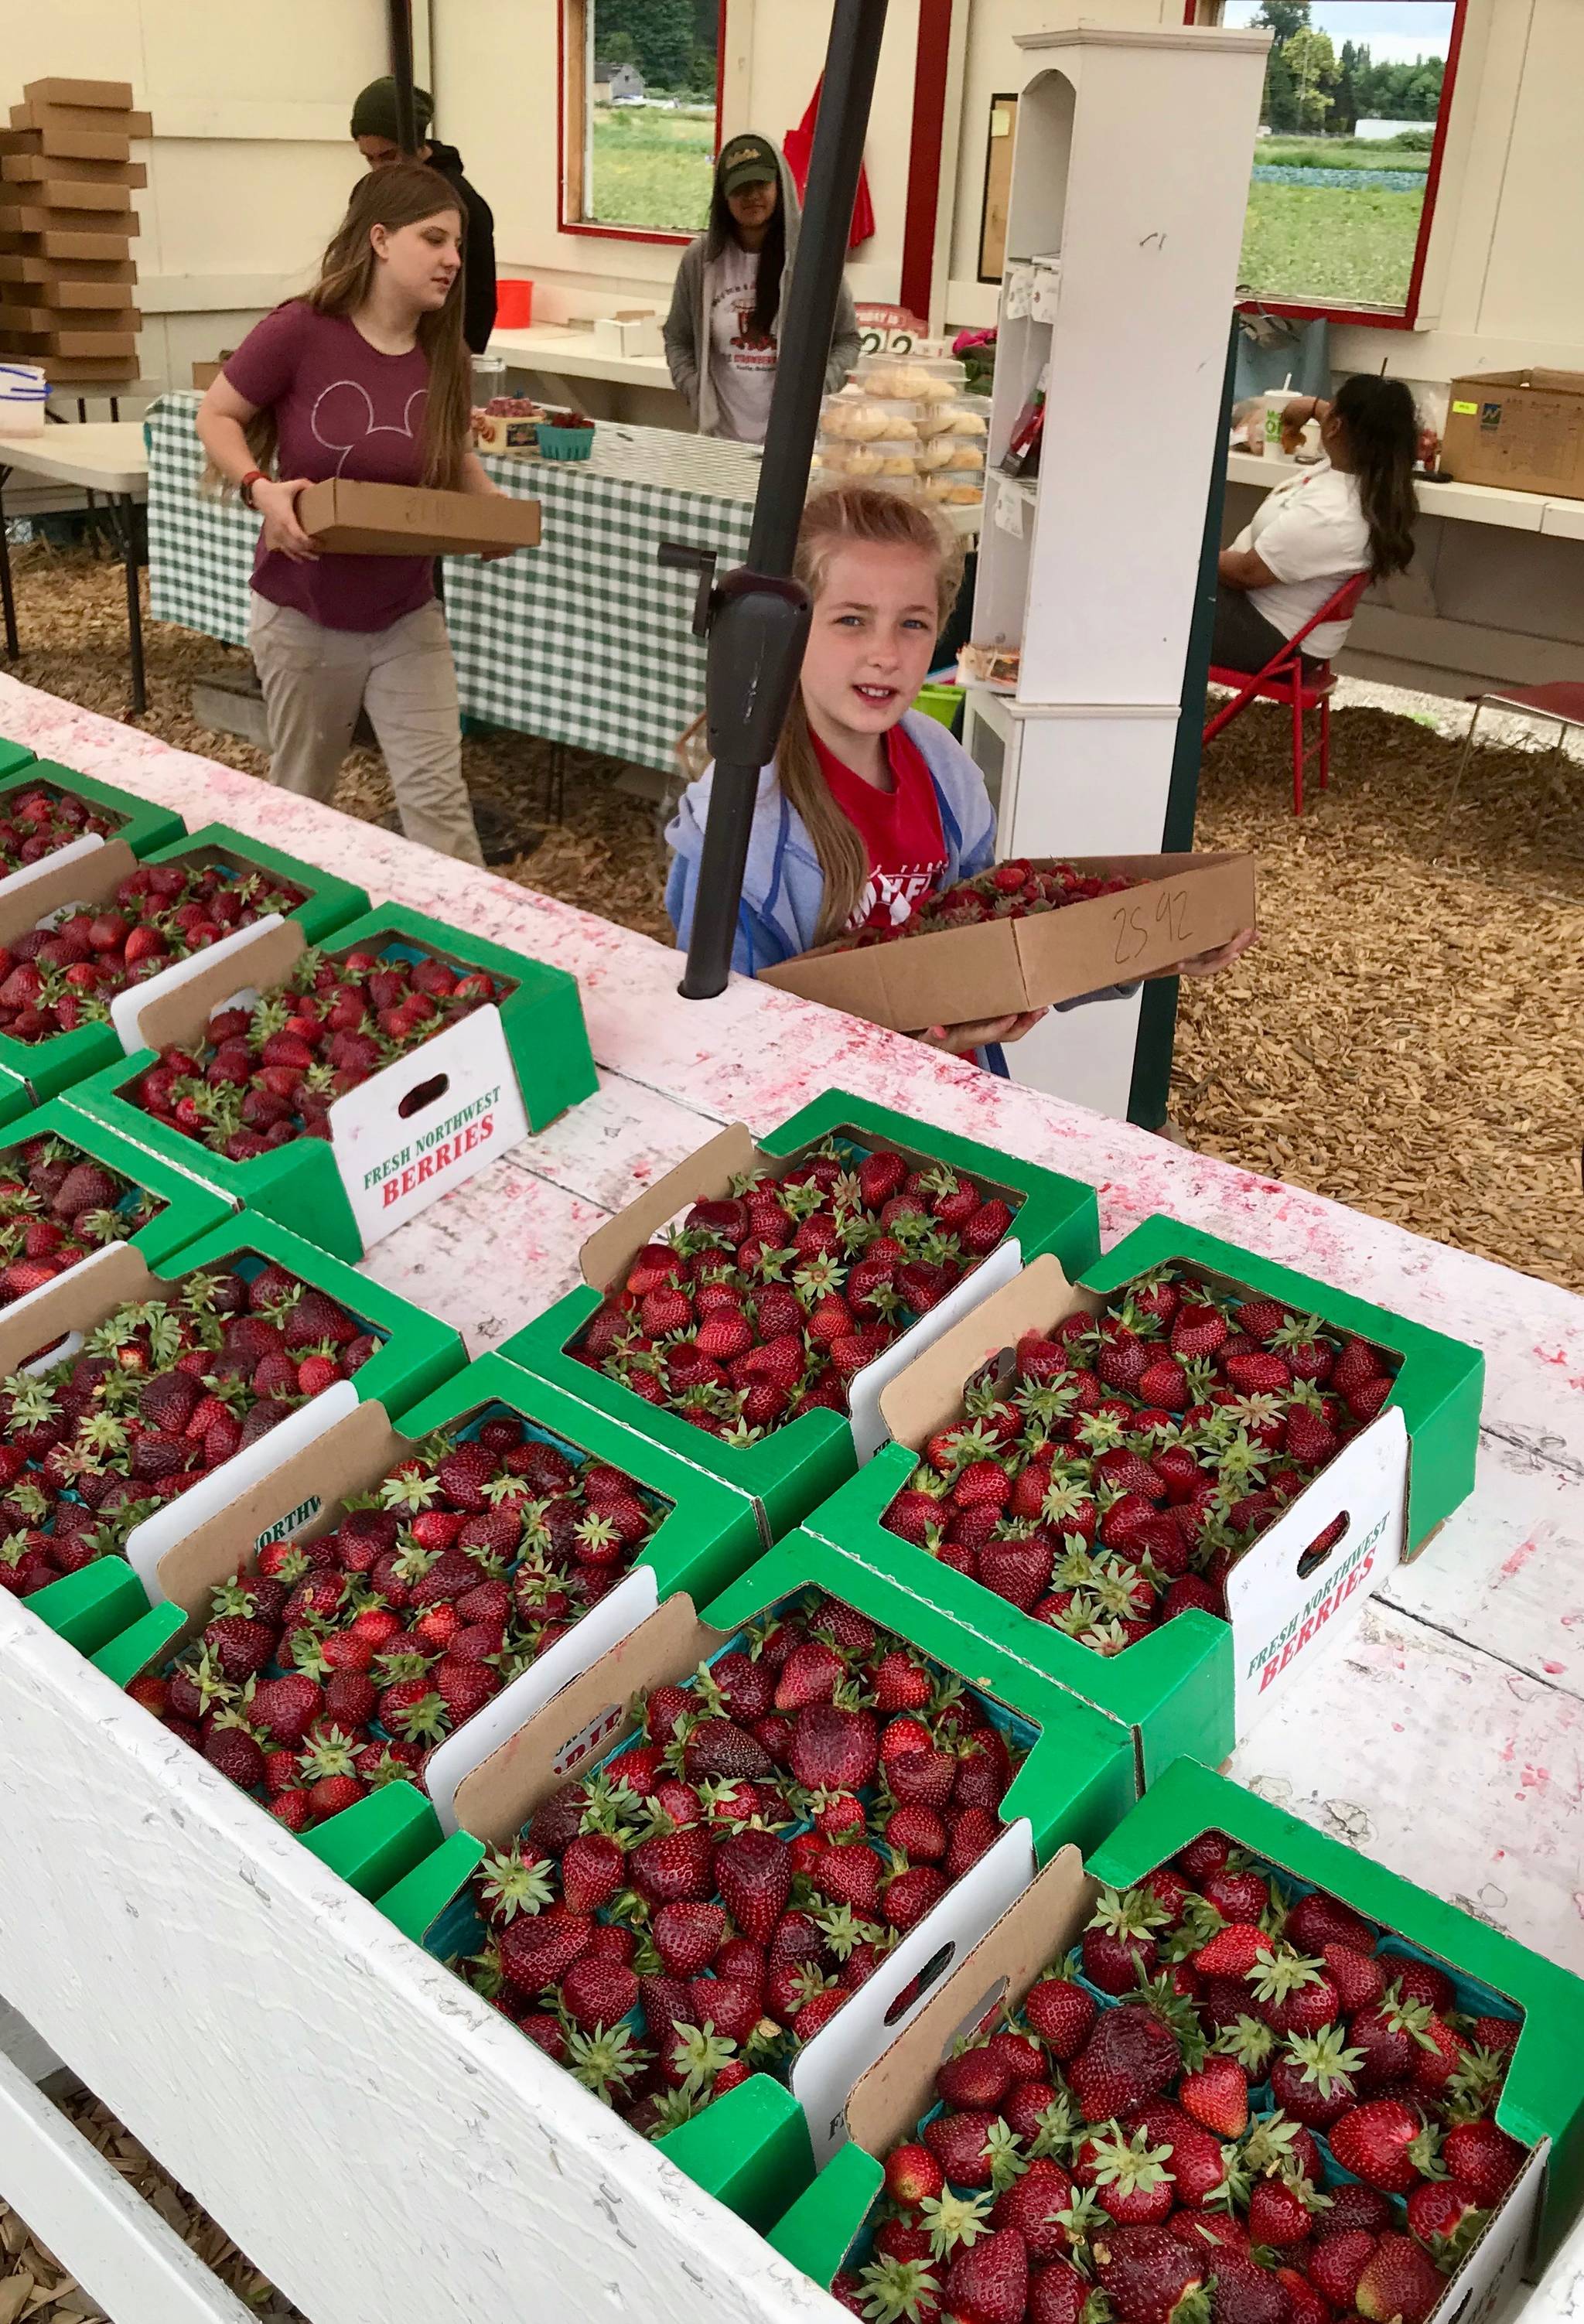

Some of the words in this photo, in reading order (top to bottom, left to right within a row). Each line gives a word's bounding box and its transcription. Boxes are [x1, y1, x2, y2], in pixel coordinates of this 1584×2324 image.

[364, 1146, 411, 1191] FRESH
[416, 1085, 500, 1156] NORTHWEST
[382, 1114, 494, 1209] BERRIES
[1246, 1612, 1299, 1680] FRESH
[1302, 1510, 1390, 1622] NORTHWEST
[1258, 1546, 1377, 1695] BERRIES
